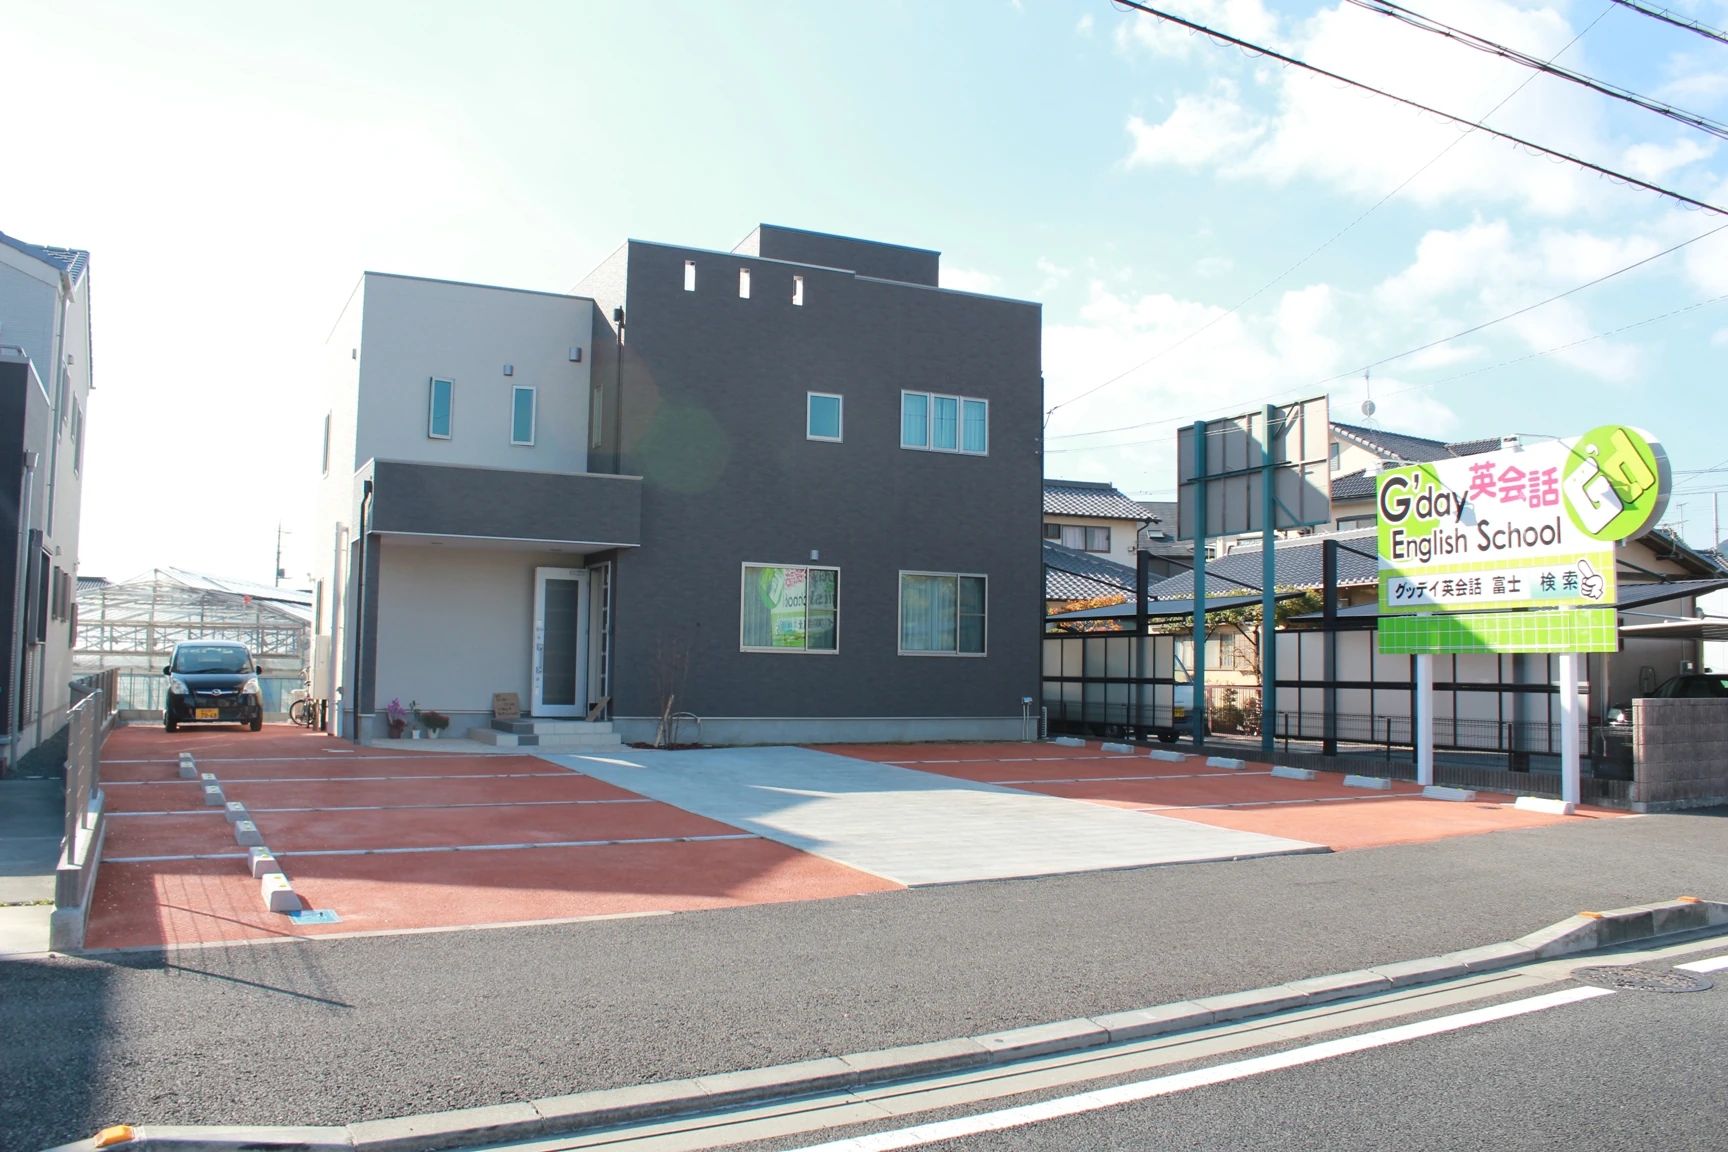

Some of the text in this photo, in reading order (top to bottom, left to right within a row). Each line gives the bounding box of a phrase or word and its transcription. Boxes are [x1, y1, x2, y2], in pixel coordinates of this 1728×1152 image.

[1380, 474, 1468, 524] G'day
[1469, 461, 1559, 508] 英会話
[1392, 516, 1561, 563] English School
[1492, 575, 1521, 594] 富士
